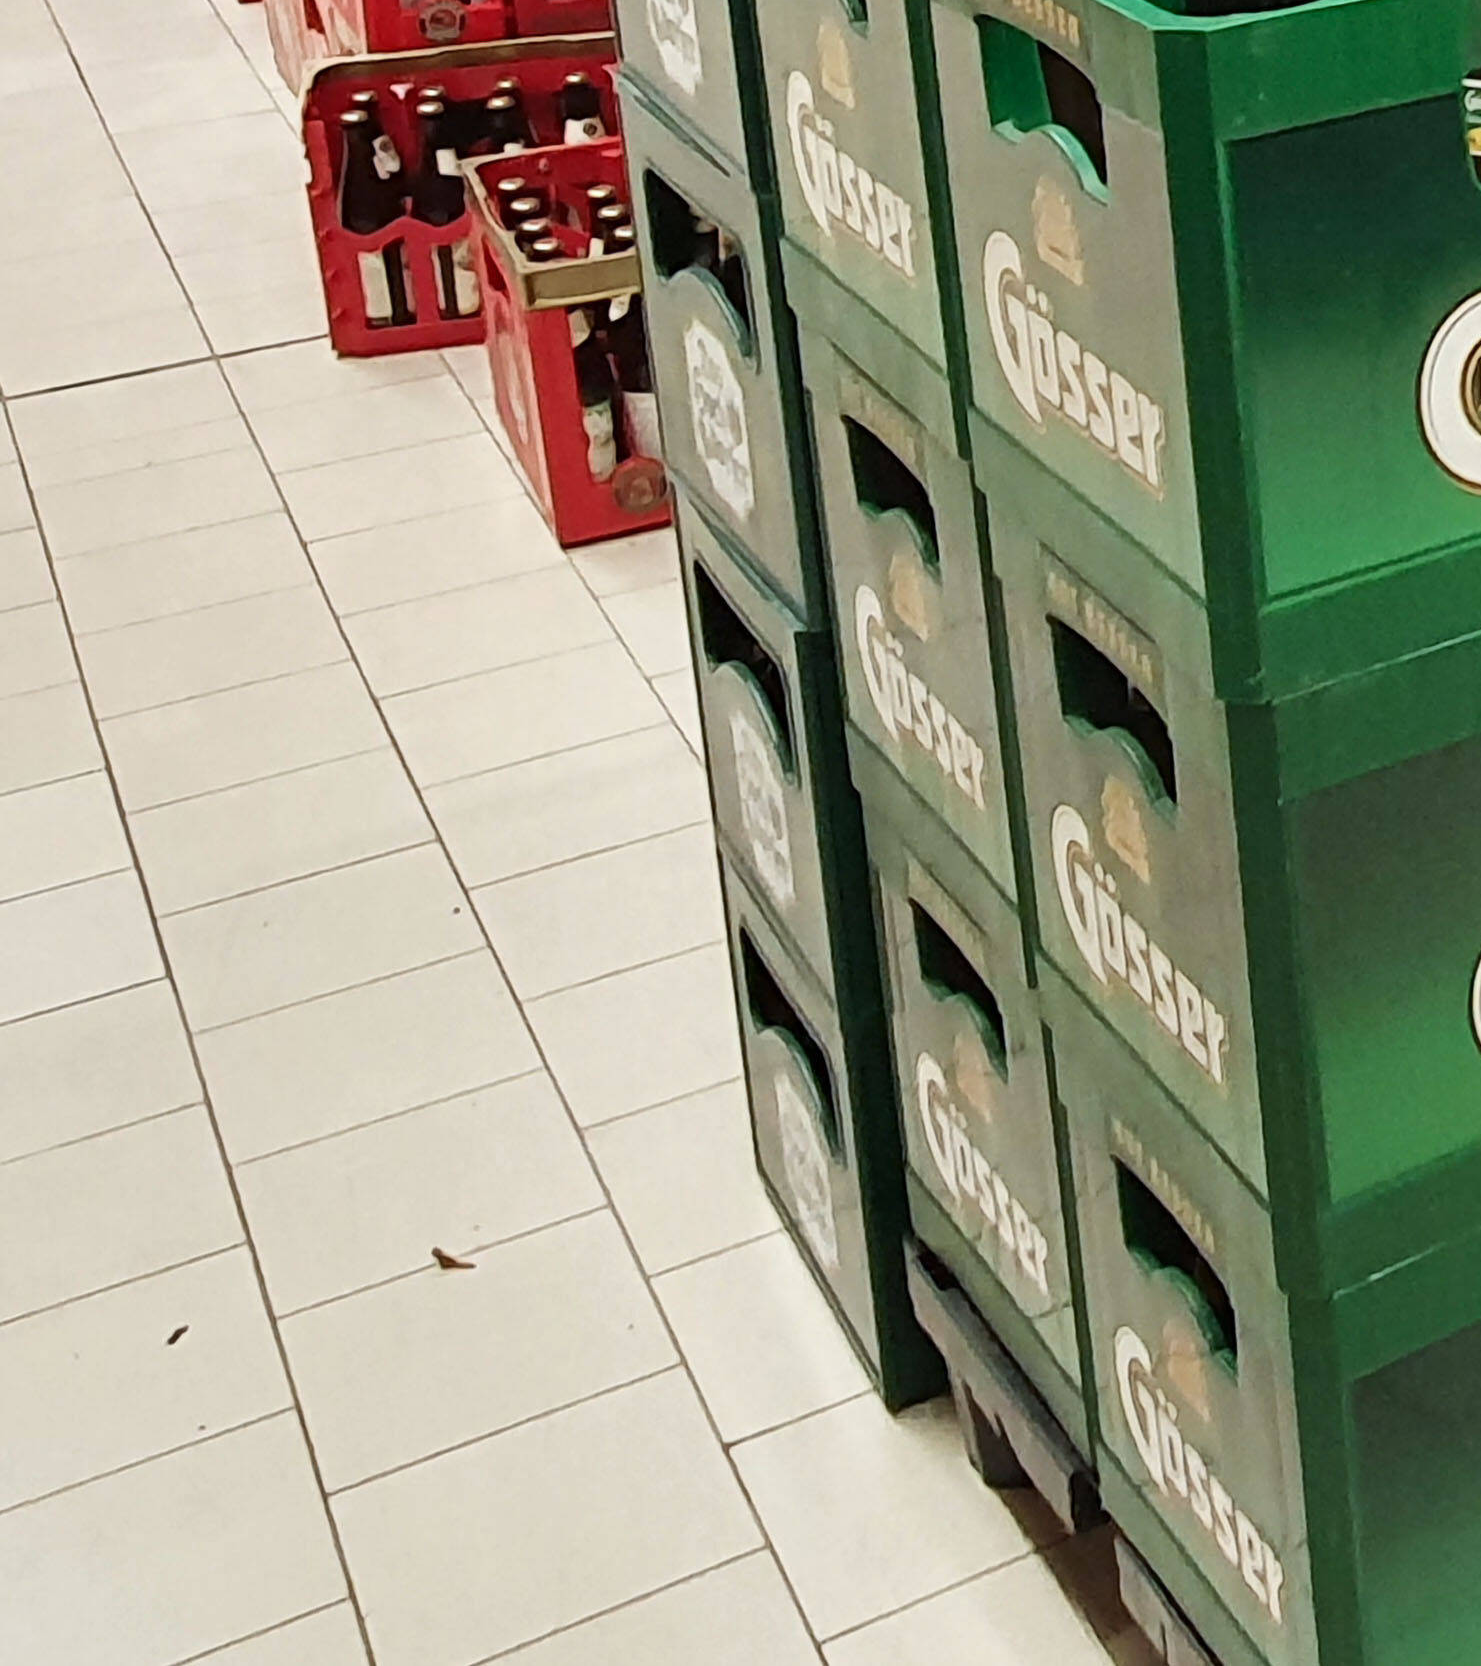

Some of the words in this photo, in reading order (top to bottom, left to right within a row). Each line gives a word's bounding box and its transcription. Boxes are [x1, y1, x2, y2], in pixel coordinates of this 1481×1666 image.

[786, 70, 915, 281] Gösser
[983, 230, 1168, 502] Gösser
[853, 583, 986, 810] Gösser
[1049, 801, 1230, 1086] Gösser
[915, 1051, 1051, 1297] Gösser
[1113, 1325, 1283, 1623] Gösser
